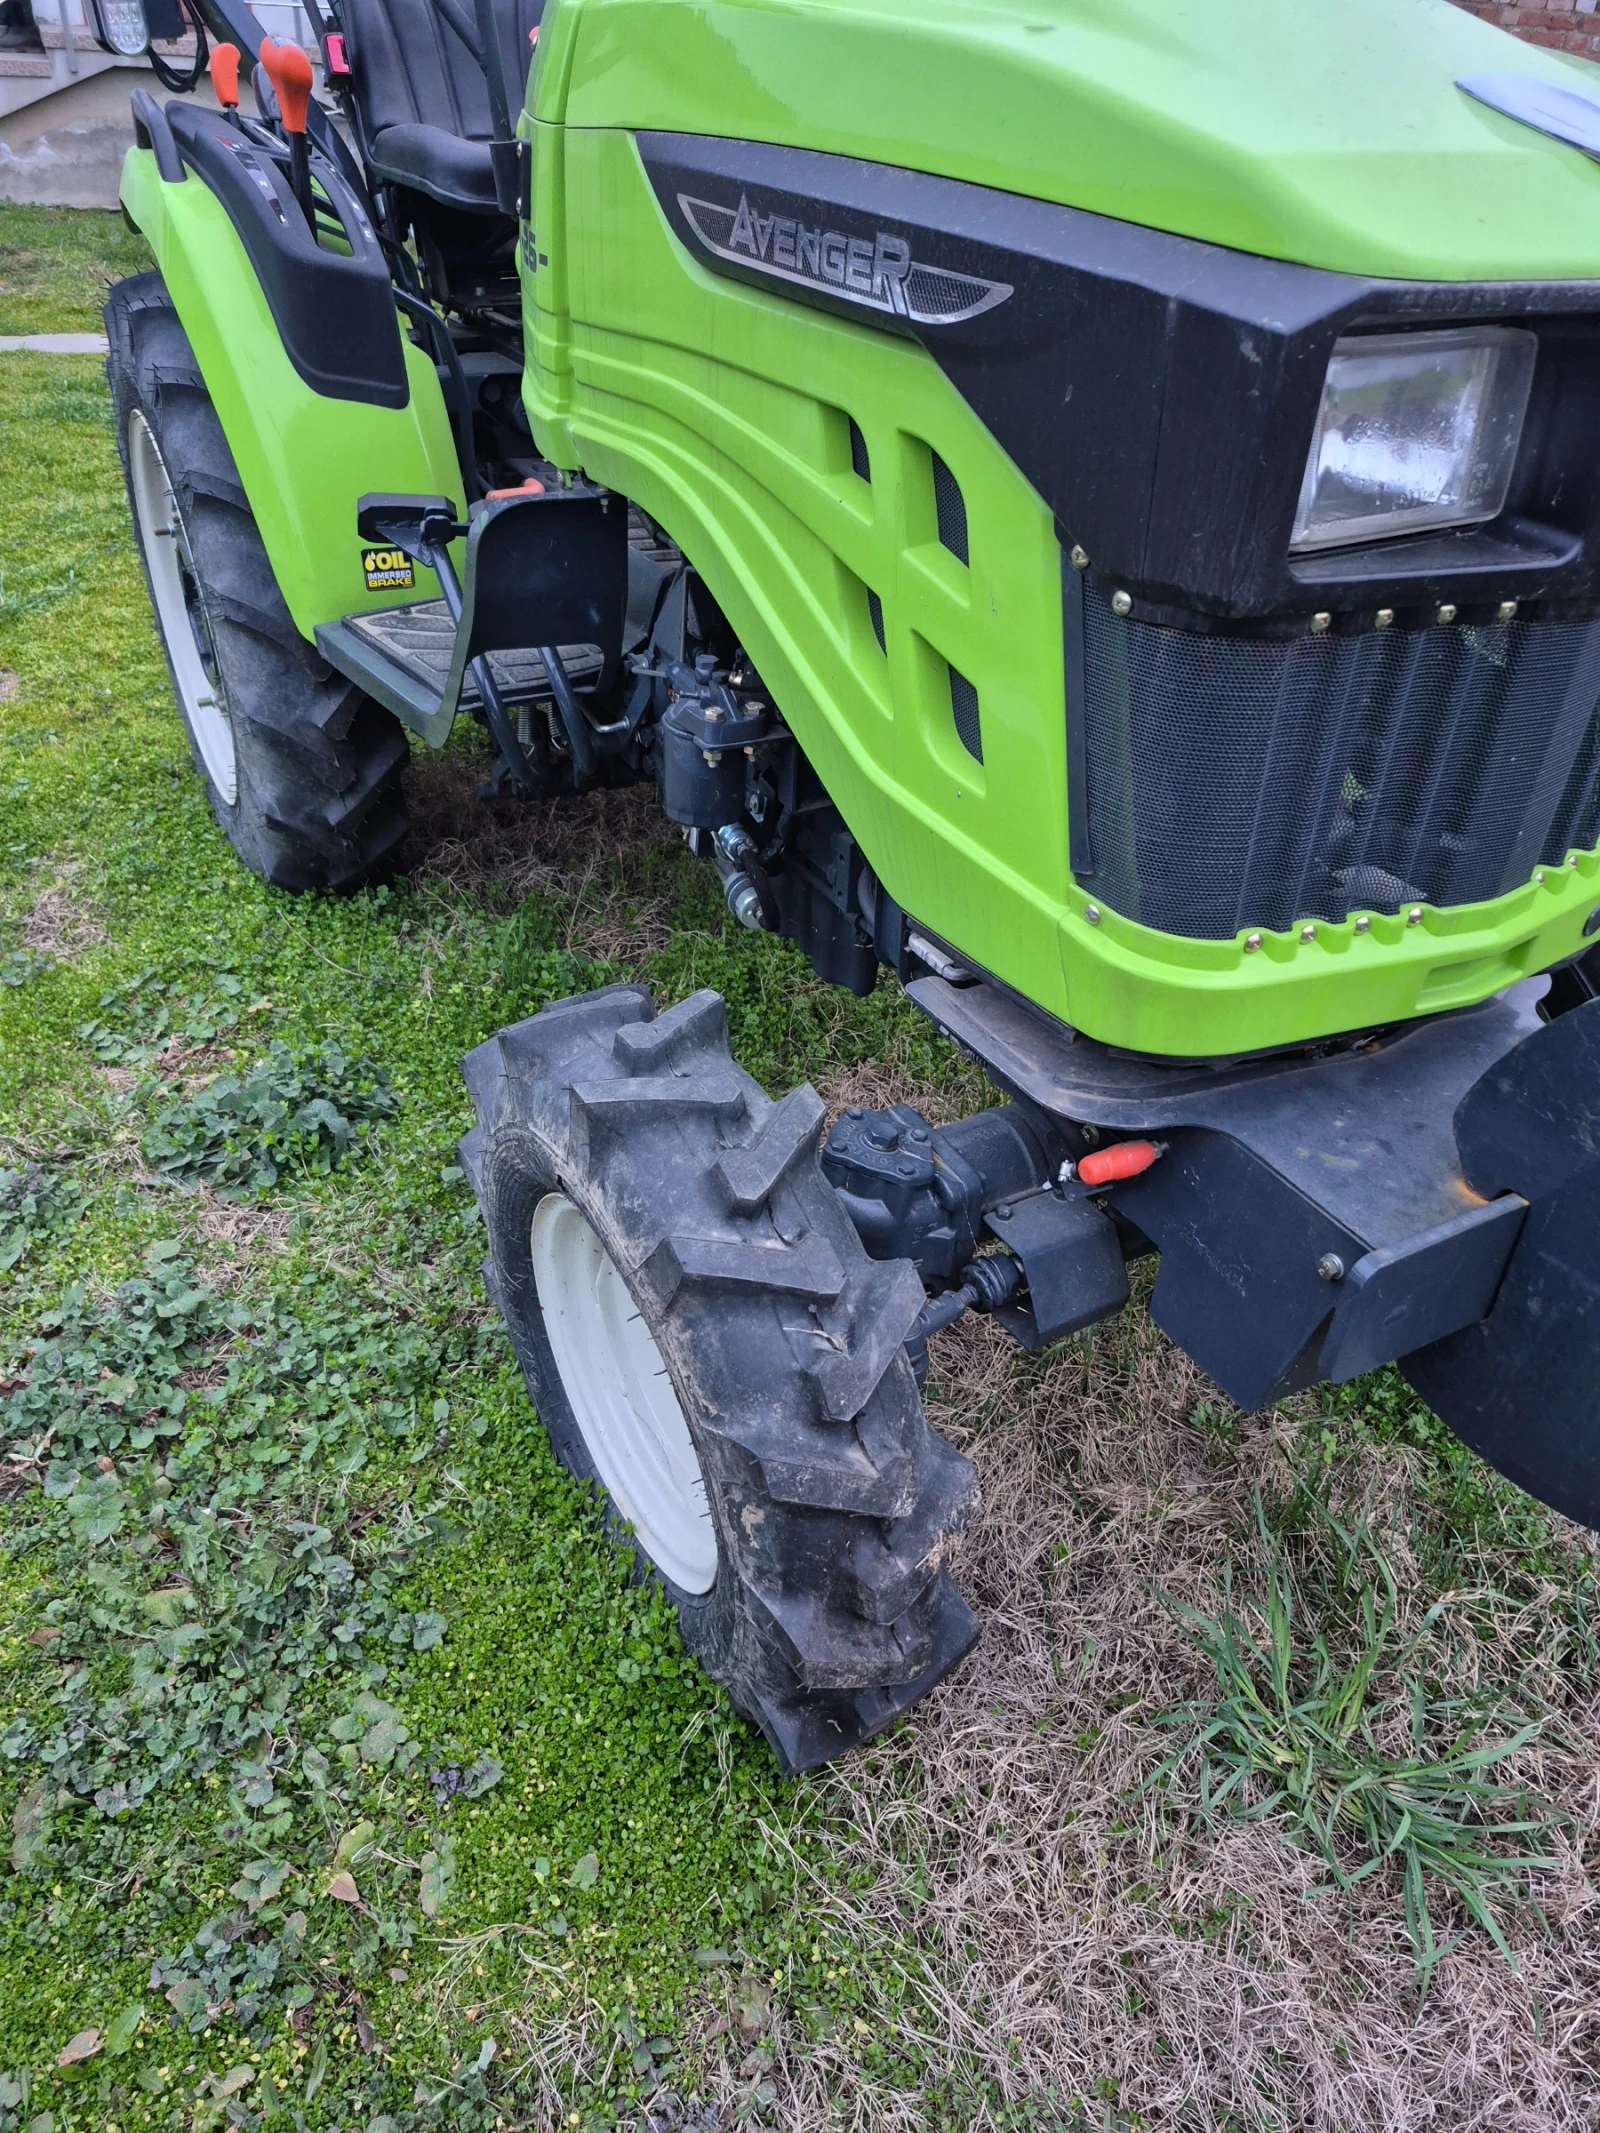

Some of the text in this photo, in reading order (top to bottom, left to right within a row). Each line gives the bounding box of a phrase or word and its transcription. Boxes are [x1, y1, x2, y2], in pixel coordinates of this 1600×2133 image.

[729, 192, 911, 318] AVENGER
[376, 550, 411, 571] OIL
[367, 569, 412, 580] IMMERSED
[368, 577, 412, 588] BRAKE
